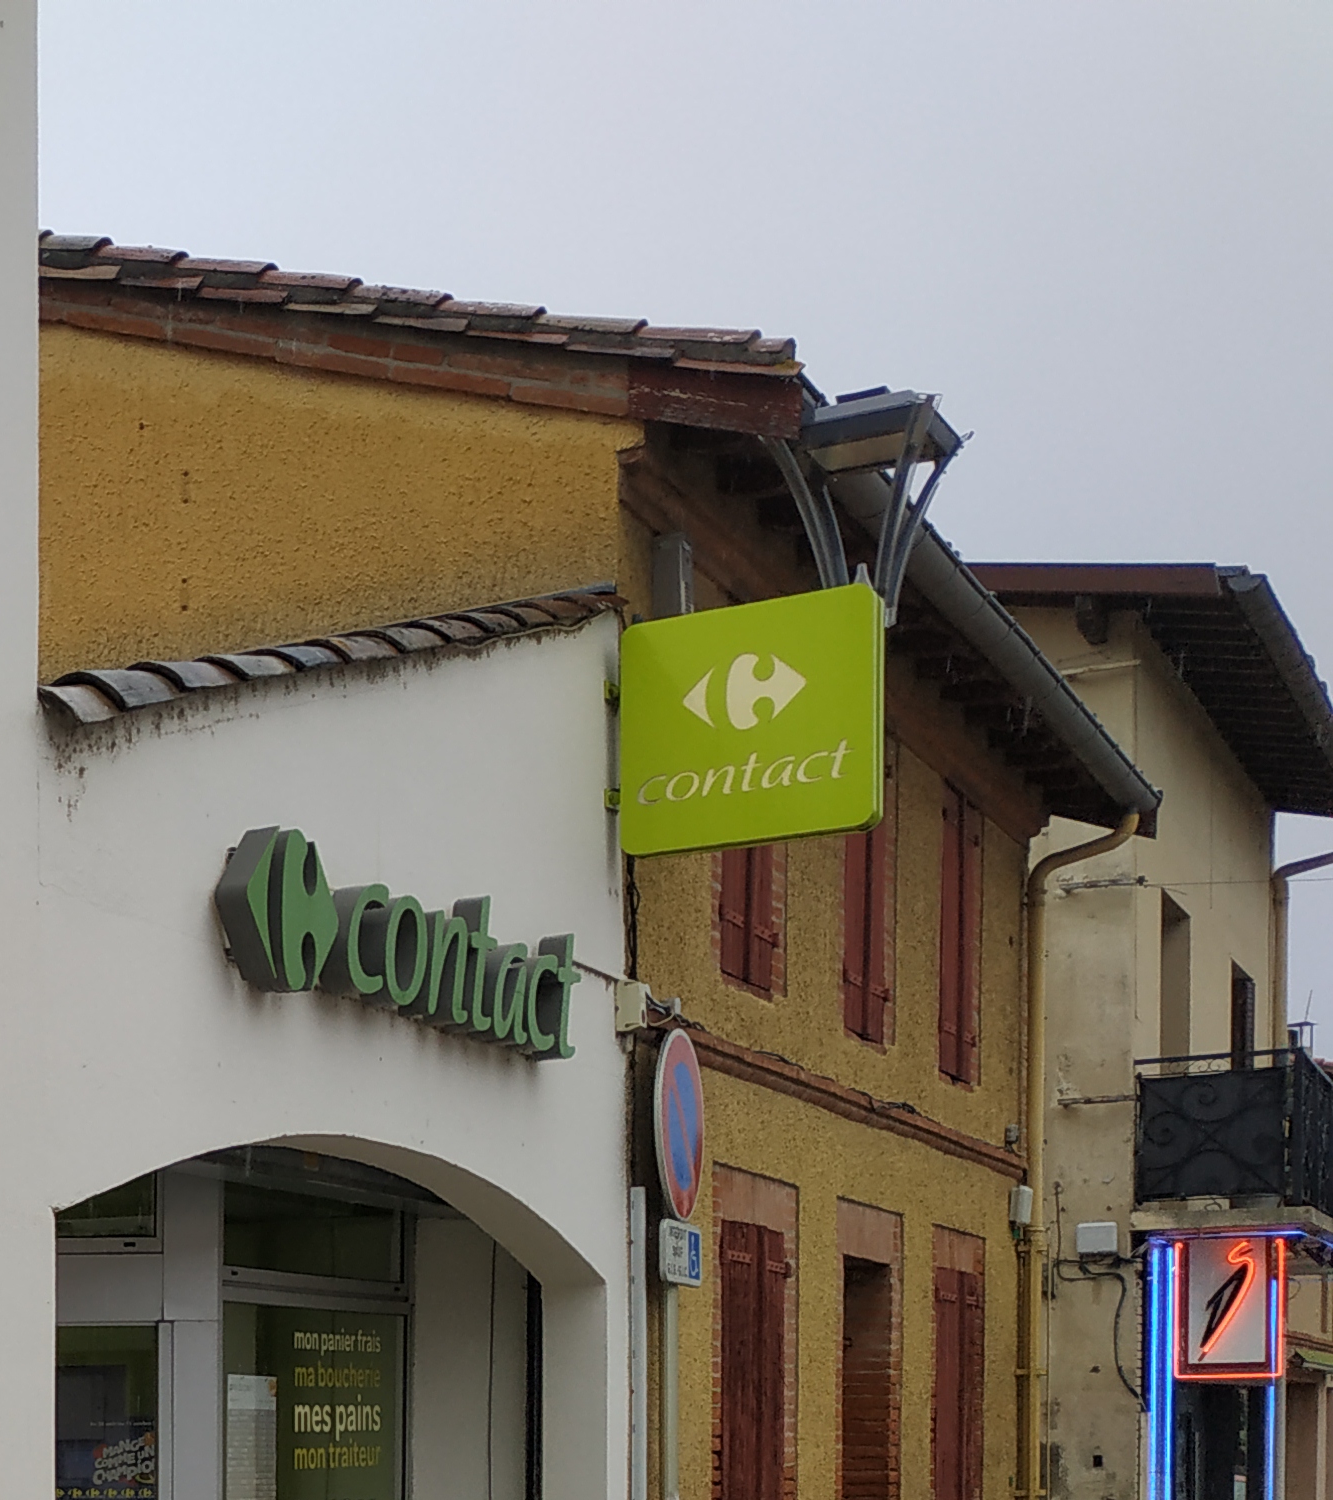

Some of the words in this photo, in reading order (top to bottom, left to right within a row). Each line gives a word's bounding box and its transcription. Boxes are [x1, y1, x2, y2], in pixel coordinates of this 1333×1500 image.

[636, 738, 855, 806] contact
[341, 883, 582, 1060] contact
[294, 1331, 319, 1350] mon
[320, 1328, 355, 1356] panier
[358, 1329, 381, 1353] frais
[294, 1366, 315, 1387] ma
[318, 1360, 381, 1388] boucherie
[294, 1404, 332, 1433] mes
[335, 1393, 381, 1442] pains
[294, 1447, 326, 1470] mon
[329, 1438, 381, 1468] traiteur
